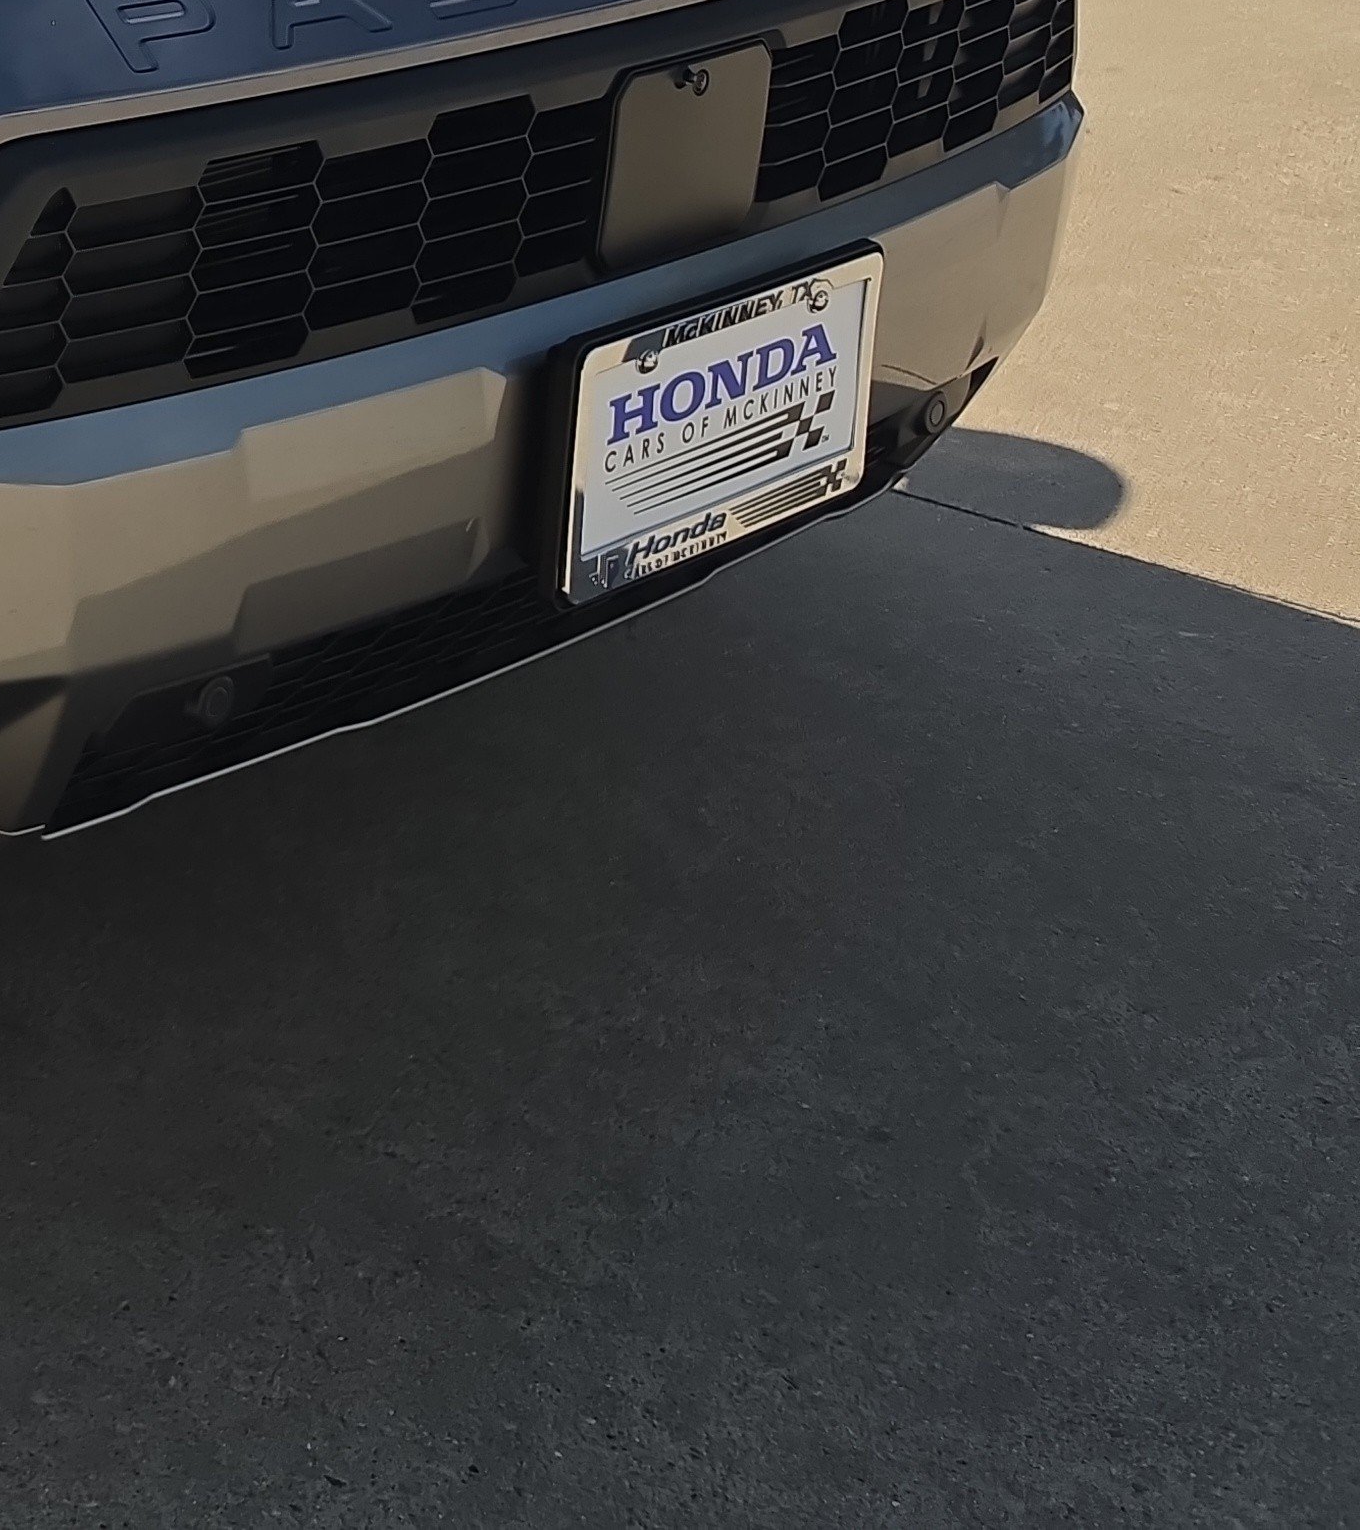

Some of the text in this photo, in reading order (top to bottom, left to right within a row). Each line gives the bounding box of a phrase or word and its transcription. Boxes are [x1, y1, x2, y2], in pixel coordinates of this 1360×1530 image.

[605, 366, 837, 473] CARS OF MCKINNEY
[607, 324, 837, 445] HONDA
[626, 512, 727, 566] Honda
